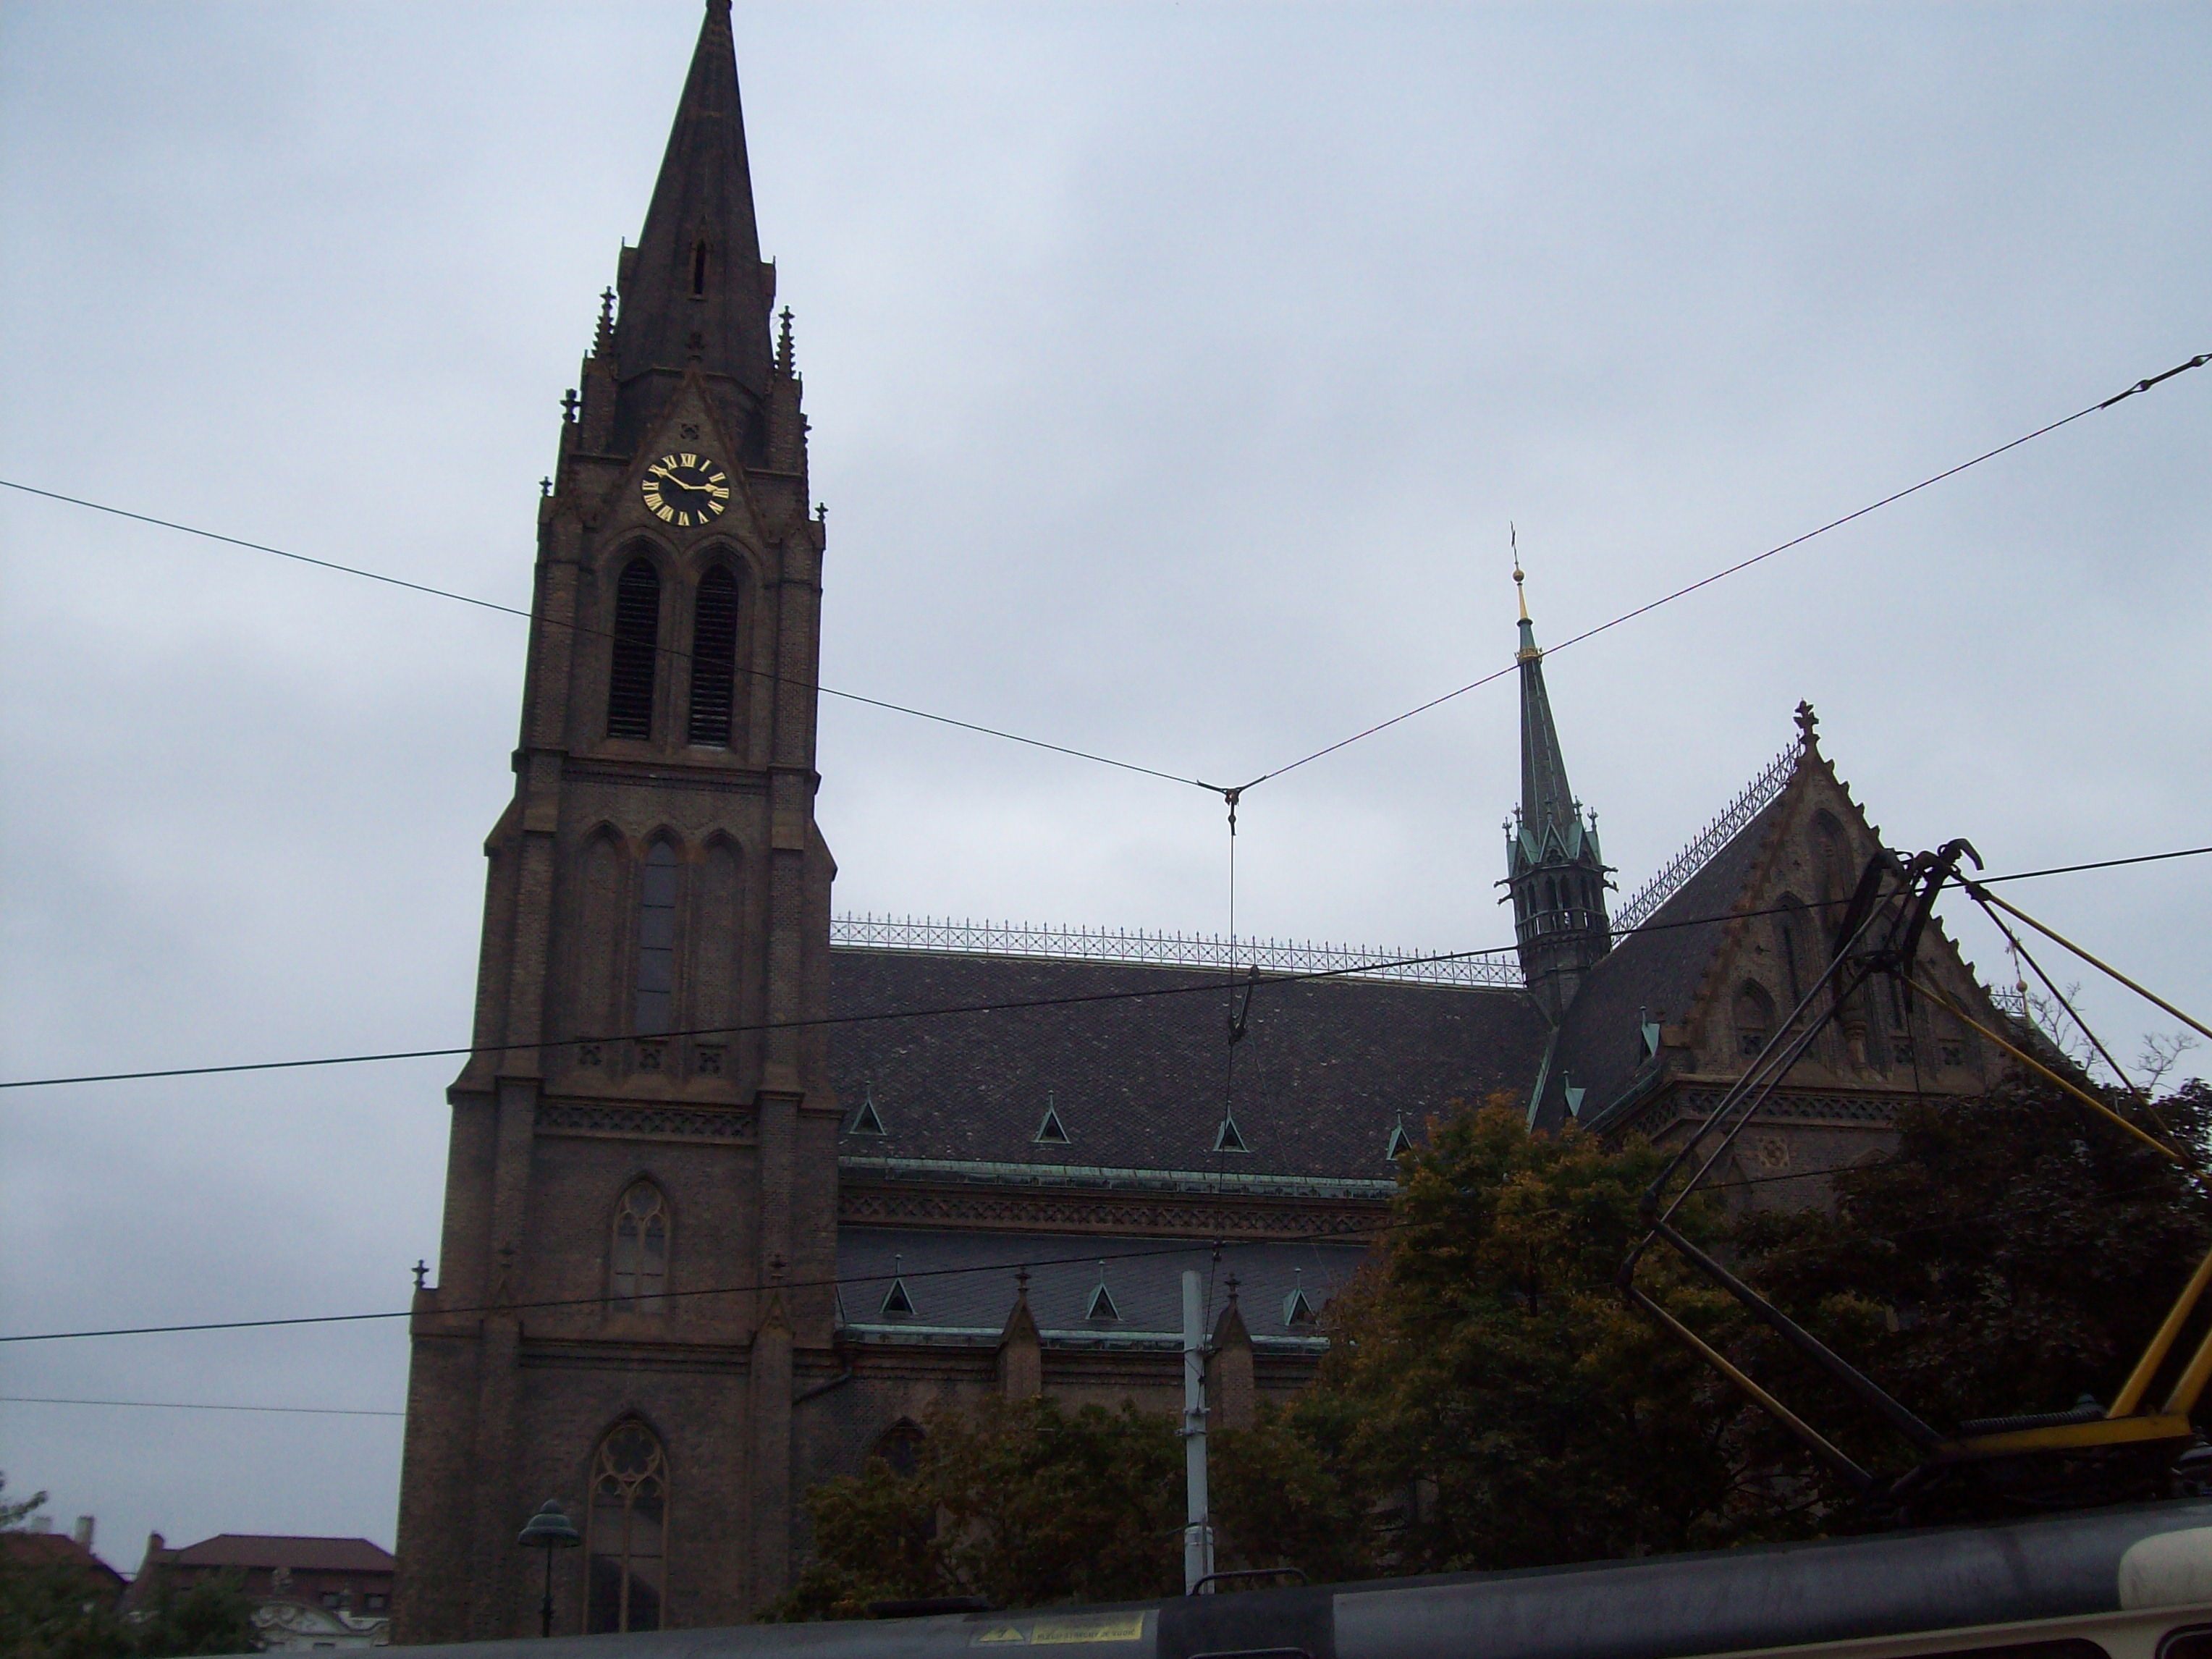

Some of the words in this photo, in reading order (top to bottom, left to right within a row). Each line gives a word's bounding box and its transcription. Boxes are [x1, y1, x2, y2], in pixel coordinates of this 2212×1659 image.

[661, 455, 677, 470] XI
[680, 453, 697, 468] XII
[699, 459, 712, 472] I
[709, 472, 726, 483] II
[642, 479, 659, 491] IX
[712, 488, 729, 499] III
[643, 493, 664, 511] VIII
[707, 500, 725, 515] IV
[656, 505, 674, 522] VII
[677, 511, 690, 525] VI
[696, 510, 709, 524] V
